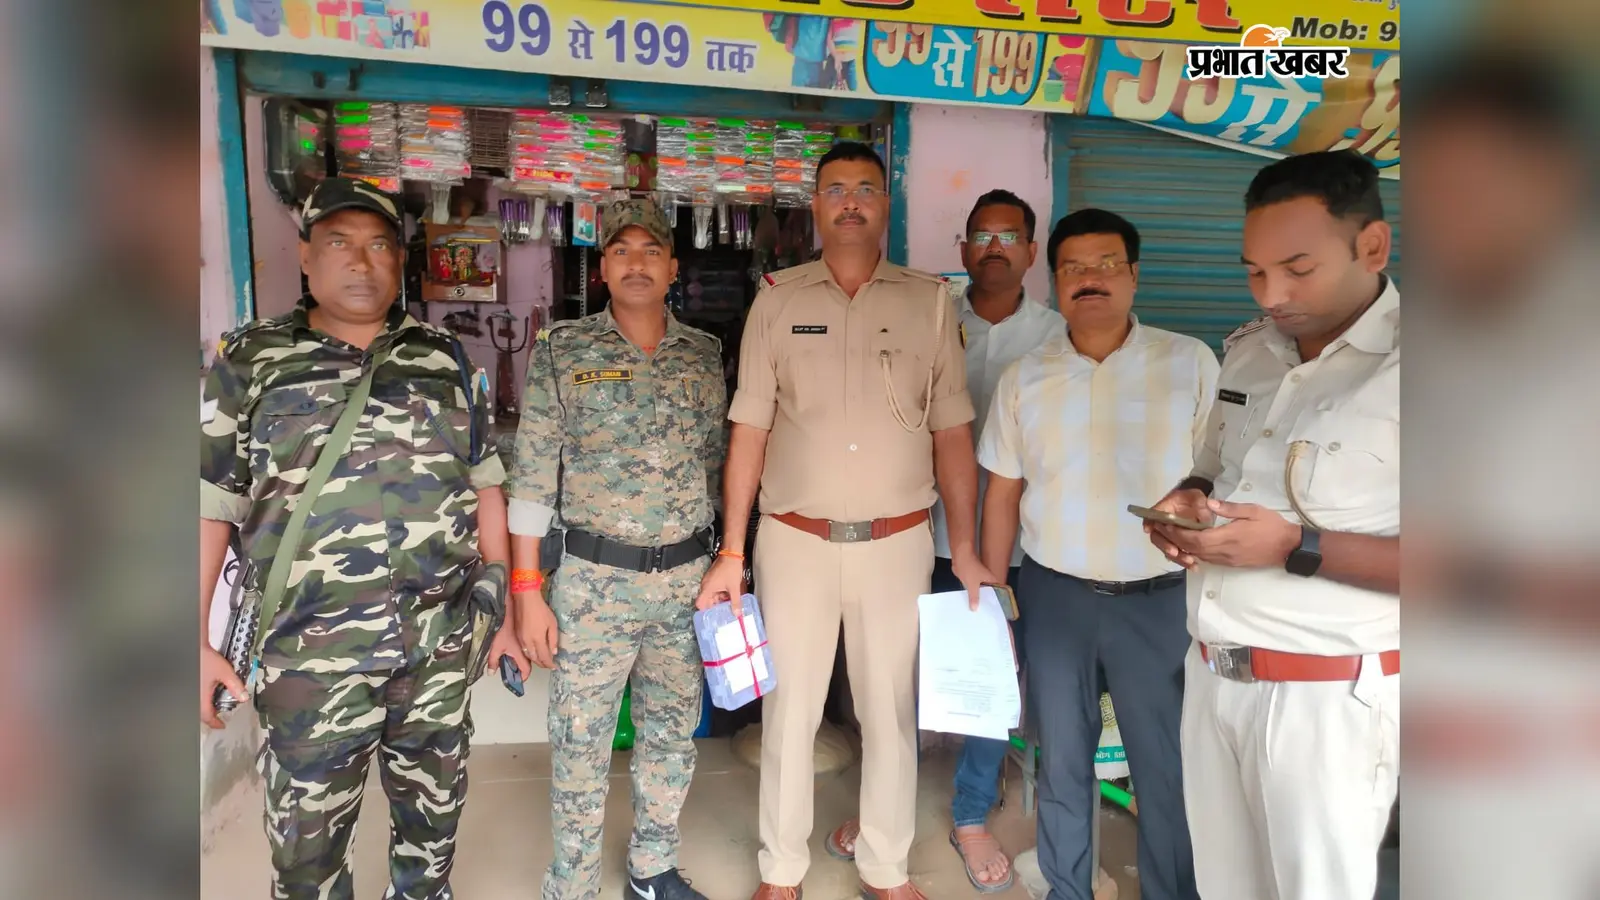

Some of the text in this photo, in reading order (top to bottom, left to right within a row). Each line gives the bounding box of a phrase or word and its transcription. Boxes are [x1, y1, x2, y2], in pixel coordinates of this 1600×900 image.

[482, 0, 757, 73] 99 से 199 तक
[932, 29, 972, 88] से
[973, 28, 1039, 98] 199
[1291, 17, 1368, 40] Mob:
